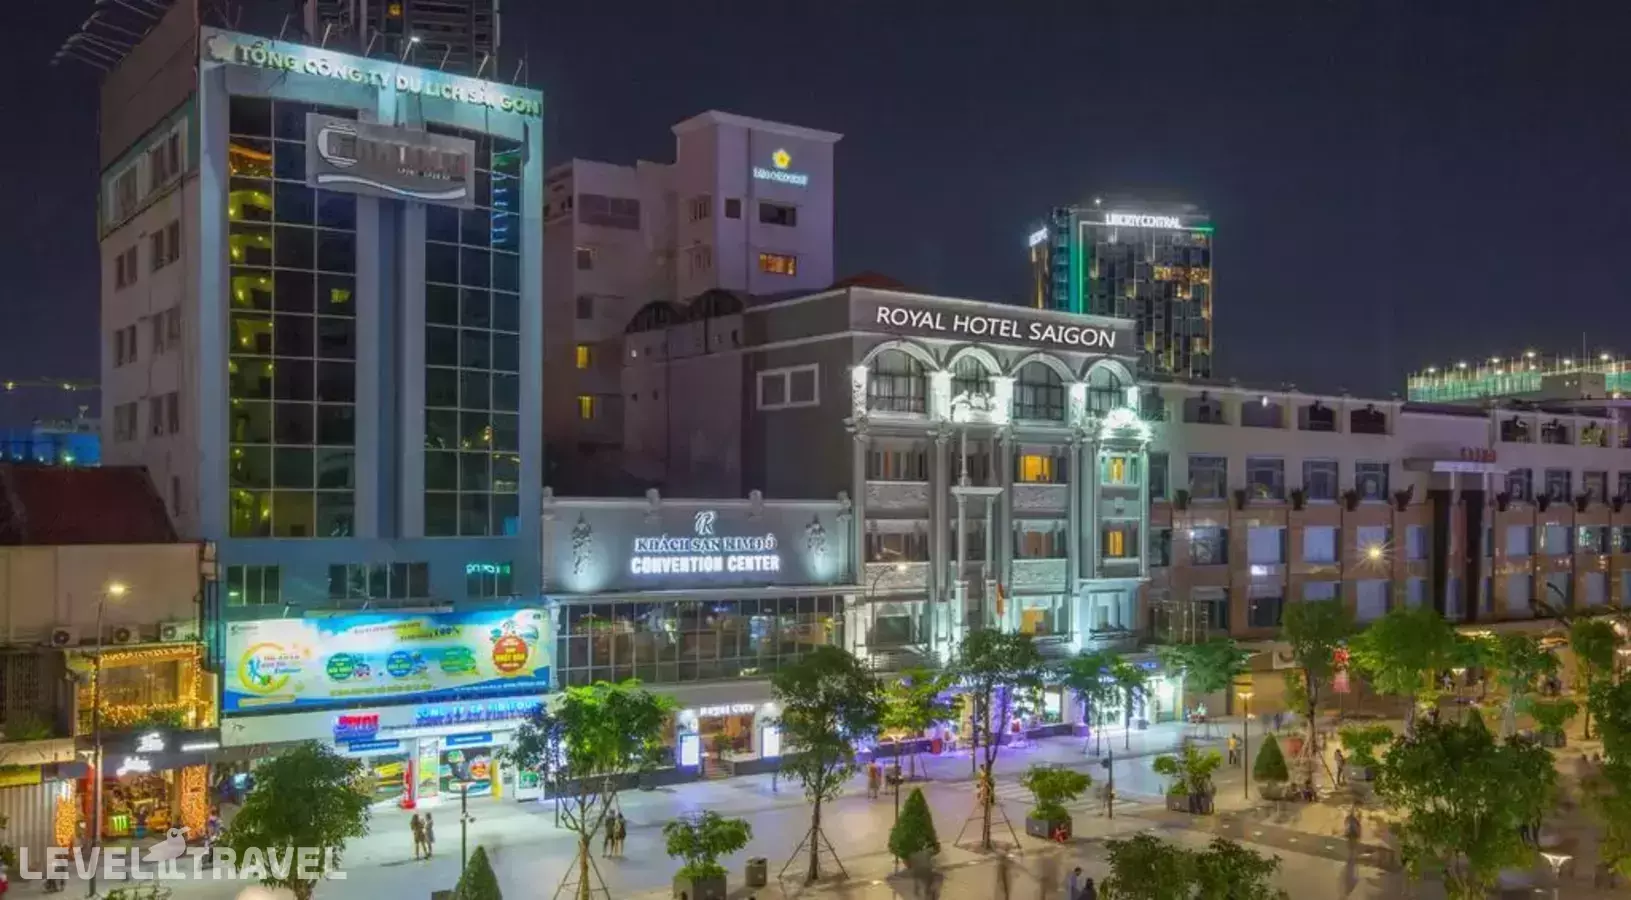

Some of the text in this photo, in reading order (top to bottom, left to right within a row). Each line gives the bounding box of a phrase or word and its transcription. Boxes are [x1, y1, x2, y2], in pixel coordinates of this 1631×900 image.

[395, 75, 421, 96] DU
[876, 306, 1116, 348] ROYAL HOTEL SAIGON
[631, 554, 781, 574] CONVENTION CENTER
